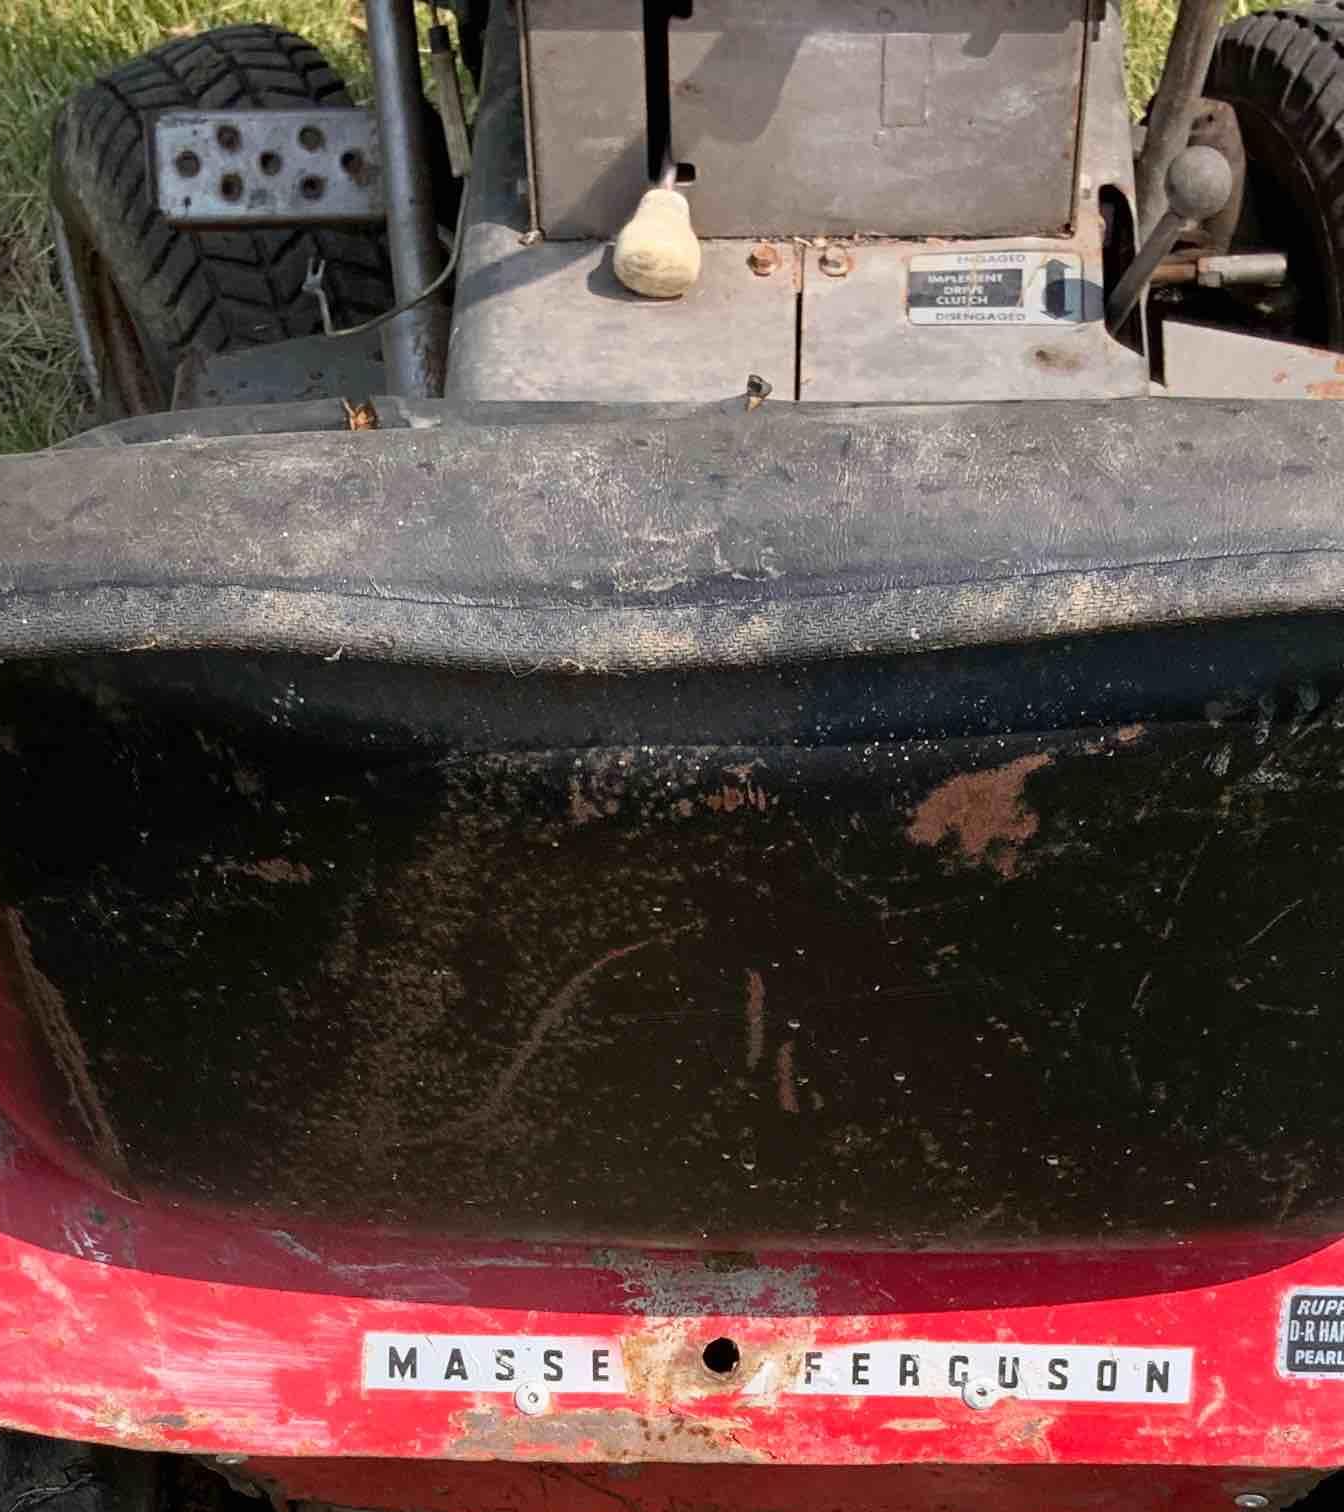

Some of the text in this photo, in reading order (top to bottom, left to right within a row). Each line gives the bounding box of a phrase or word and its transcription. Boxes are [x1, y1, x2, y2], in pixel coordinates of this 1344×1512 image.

[956, 254, 1026, 264] ENGAGED
[927, 273, 1004, 284] IMPLEMENT
[943, 286, 985, 295] DRIVE
[935, 295, 989, 306] CLUTCH
[935, 311, 1026, 321] DISENGAGED
[1289, 1319, 1316, 1342] D-R
[387, 1345, 1170, 1393] MASSE FERGUSON
